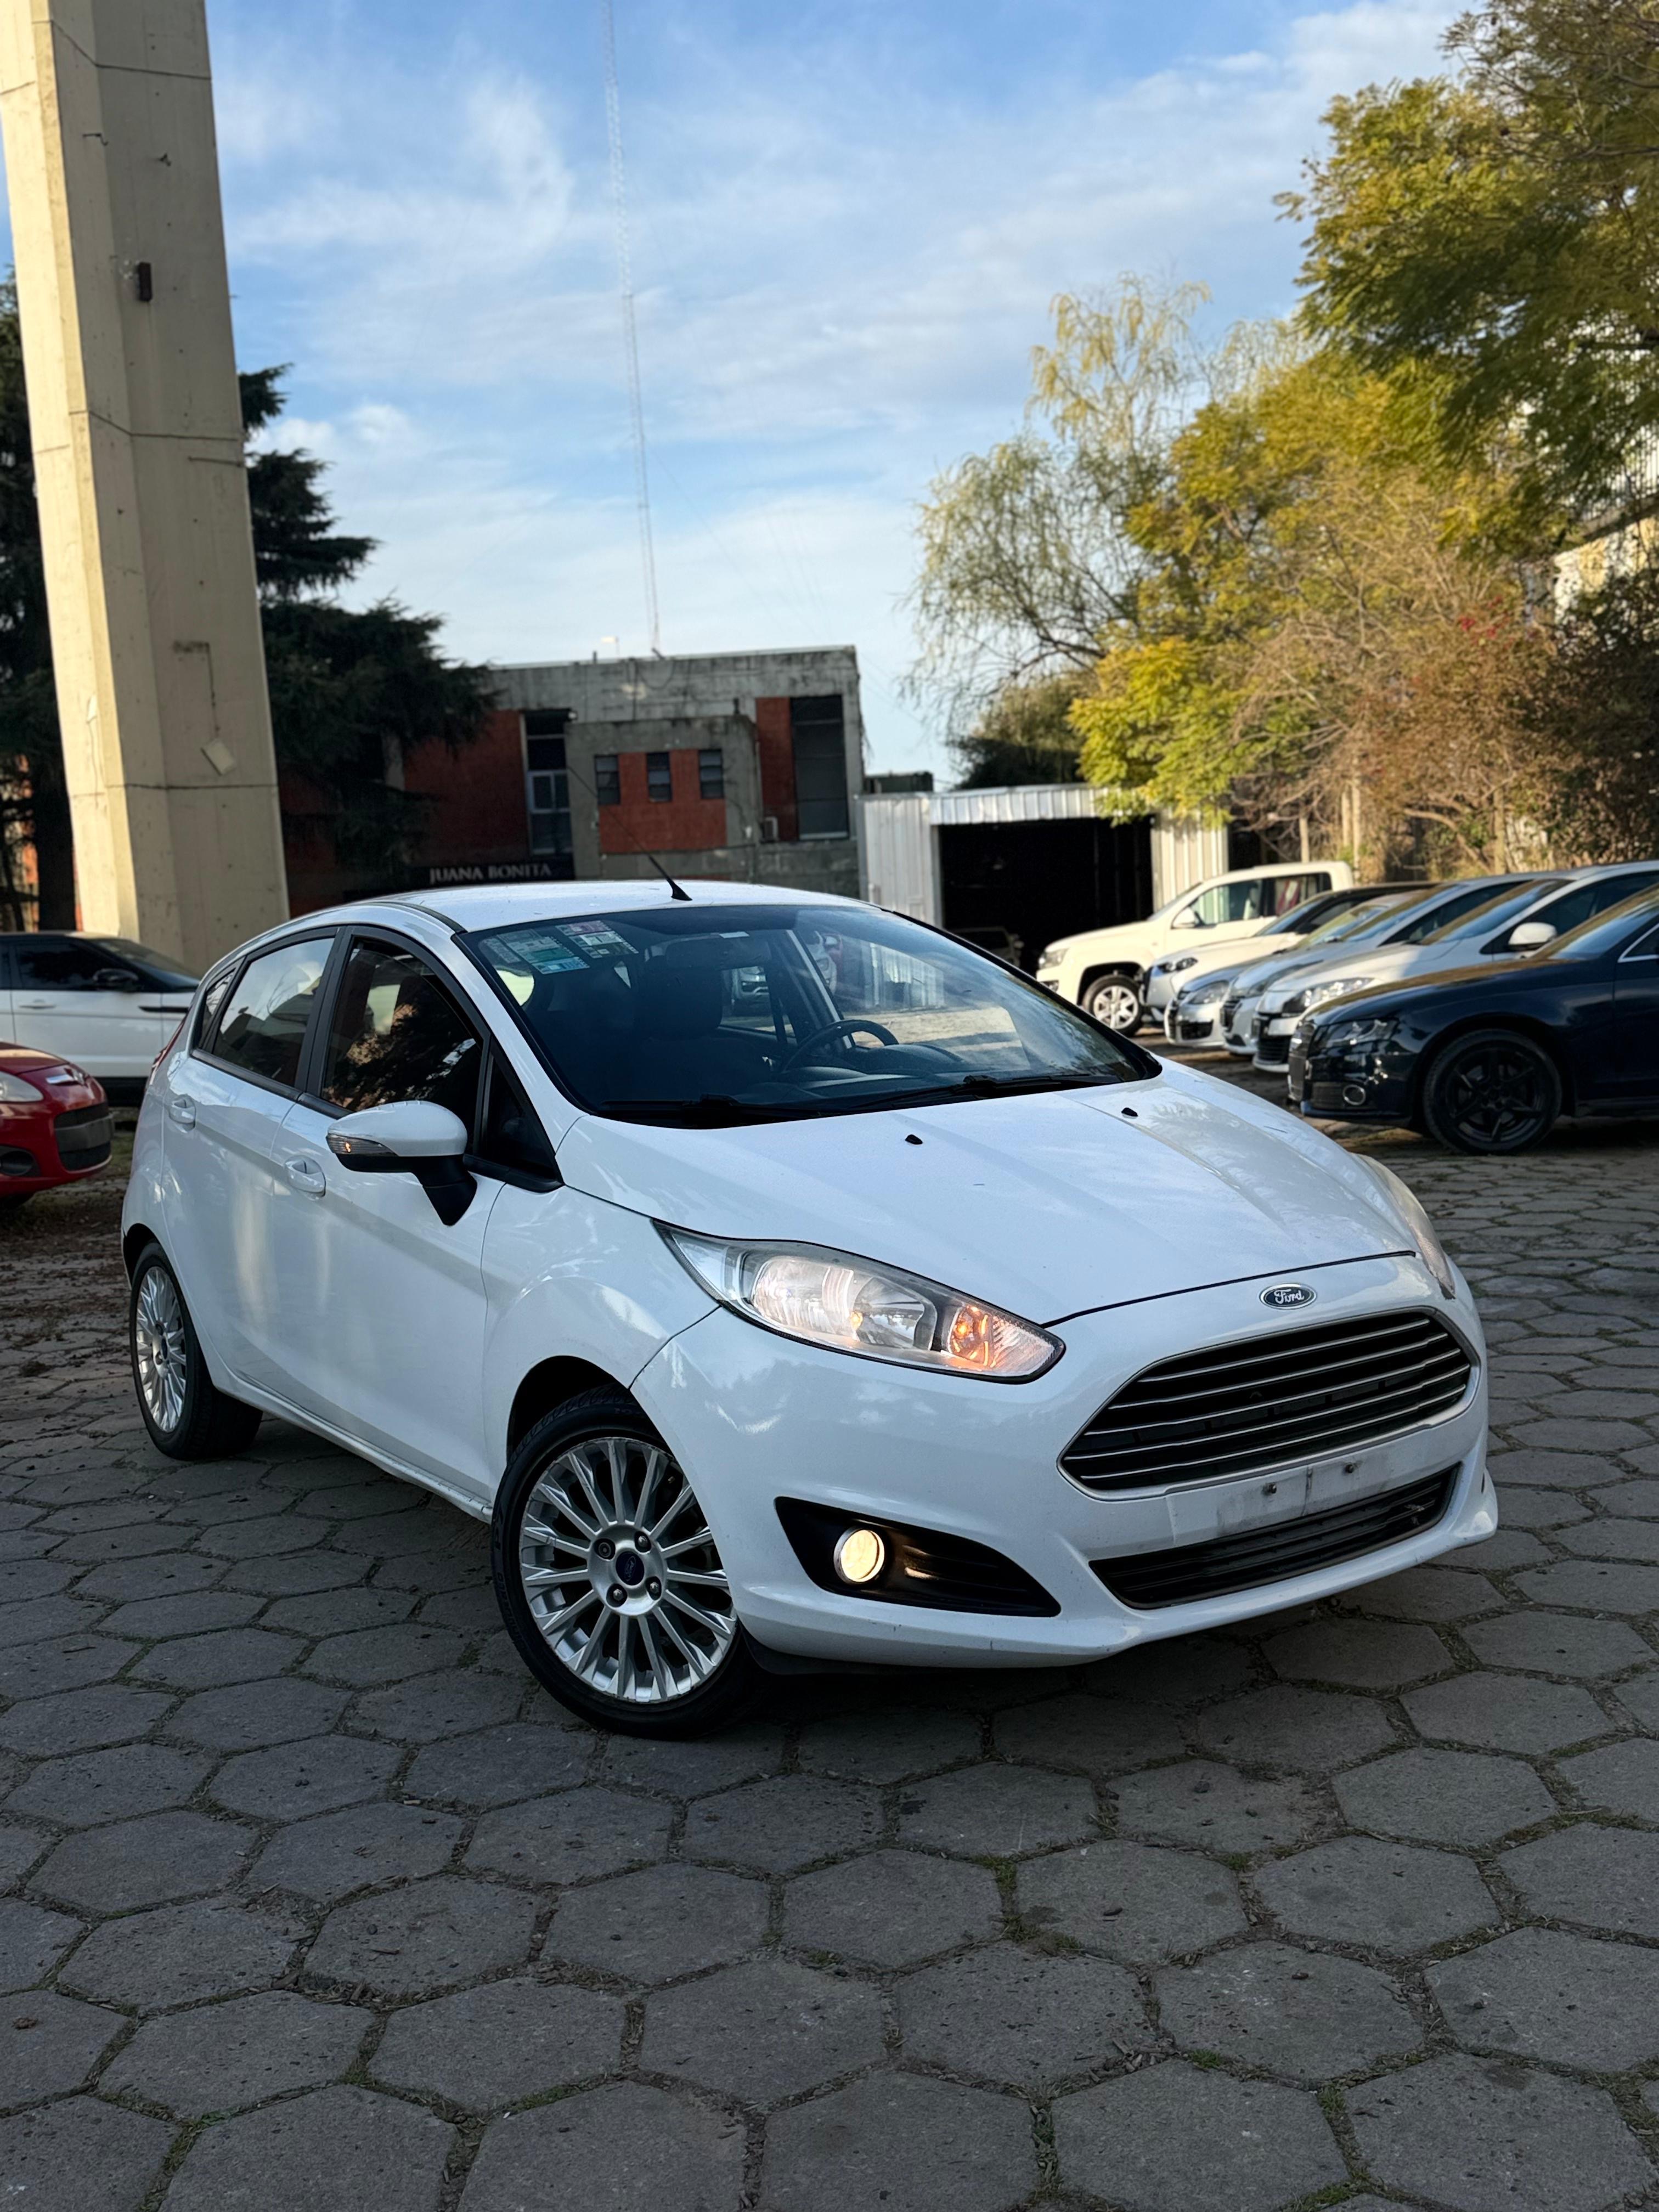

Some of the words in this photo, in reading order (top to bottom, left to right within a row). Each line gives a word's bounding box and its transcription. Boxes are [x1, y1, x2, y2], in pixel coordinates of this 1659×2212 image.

[430, 867, 483, 884] JUANA
[488, 863, 551, 878] BONITA
[1273, 1289, 1305, 1304] Ford
